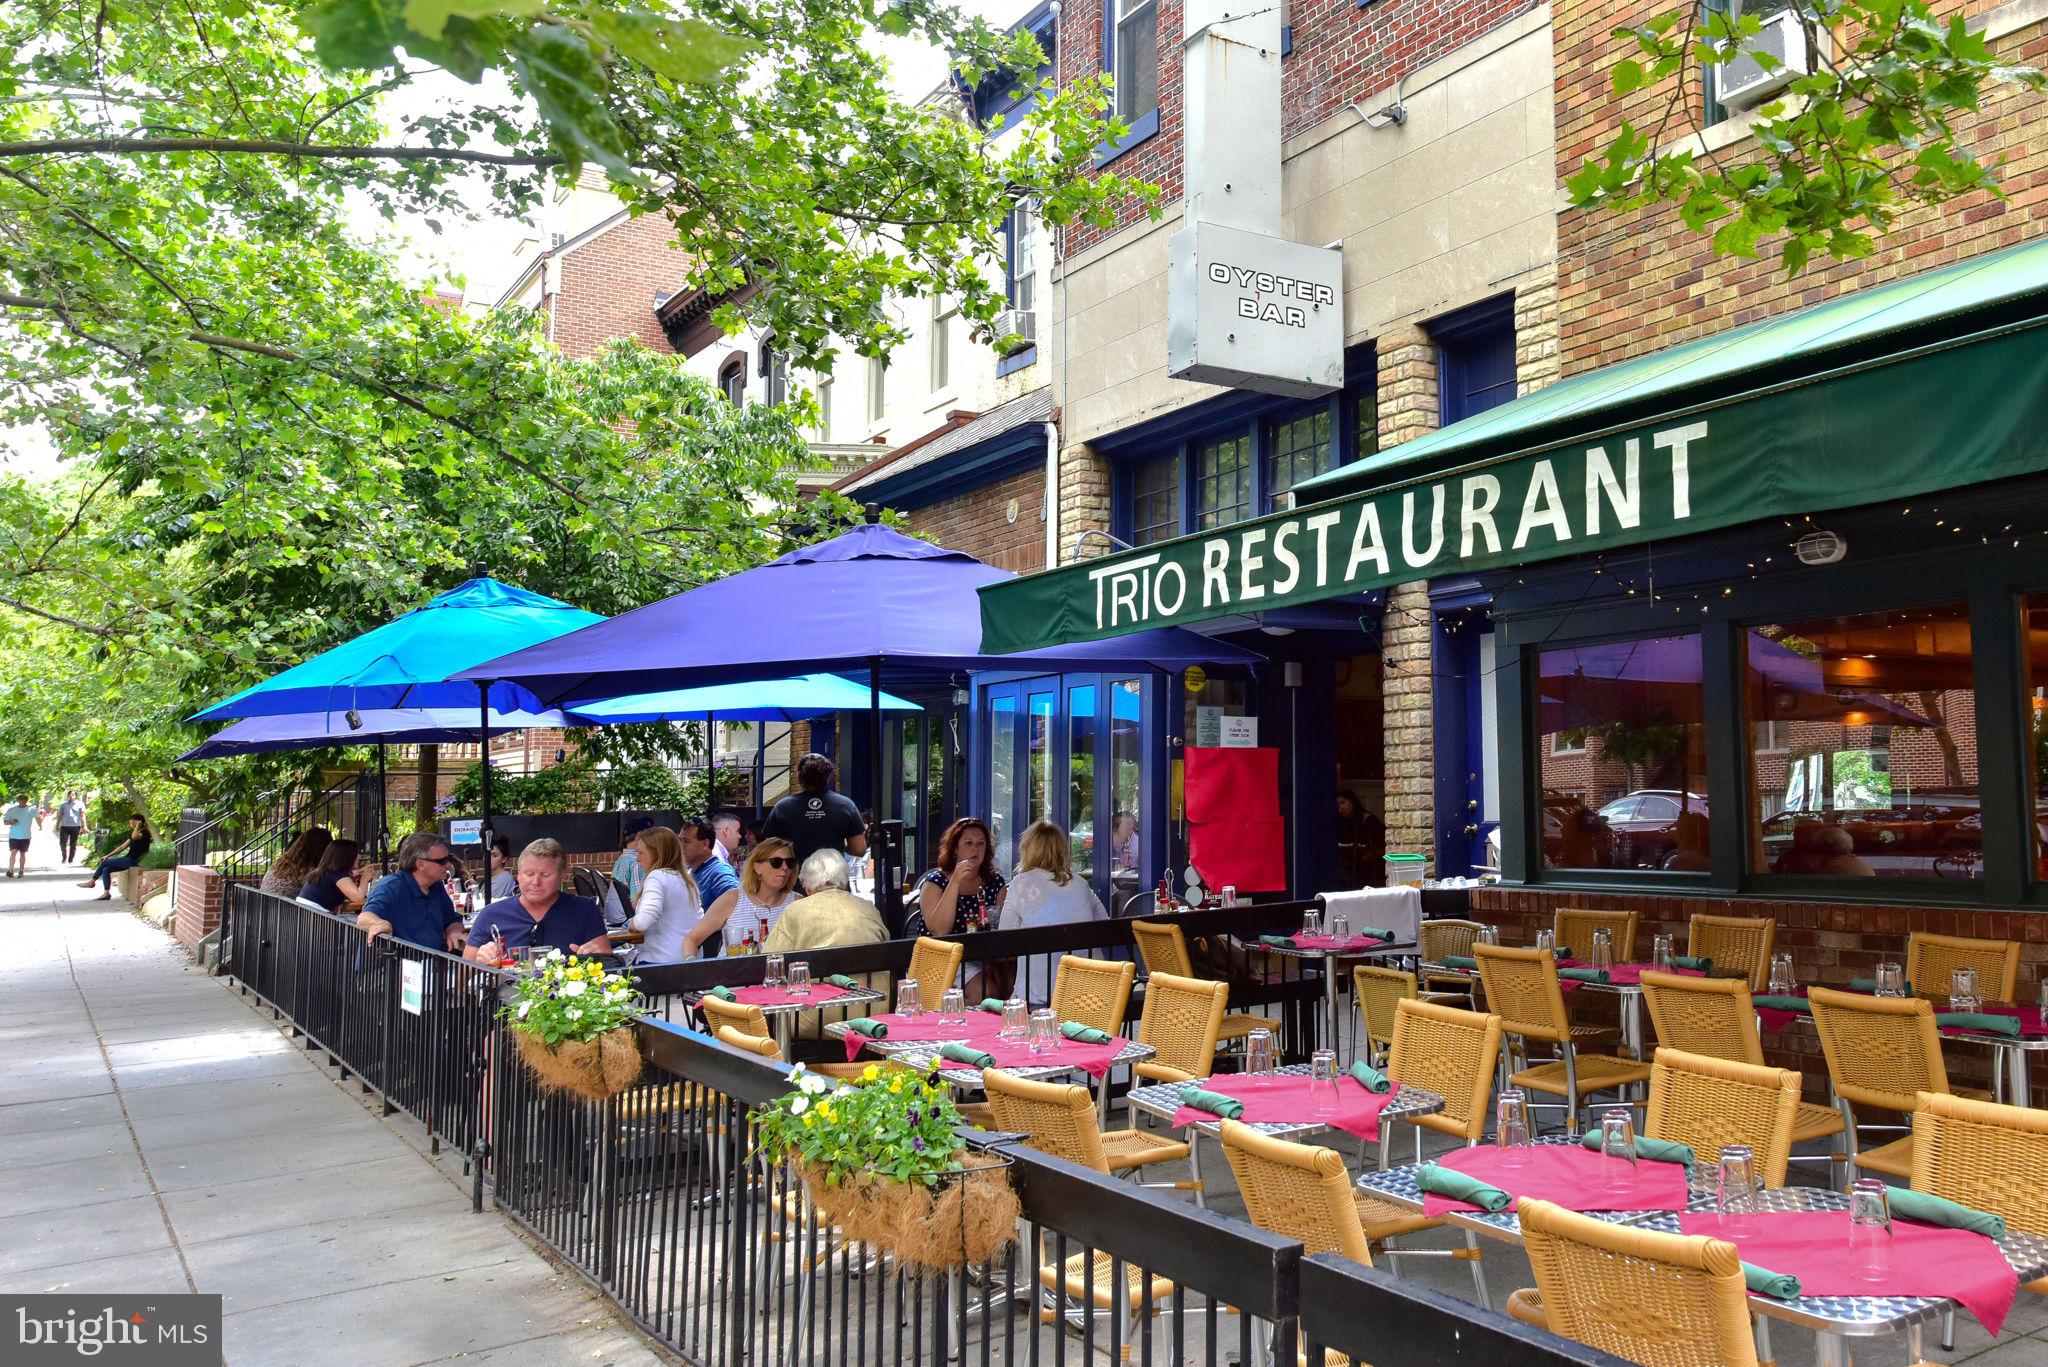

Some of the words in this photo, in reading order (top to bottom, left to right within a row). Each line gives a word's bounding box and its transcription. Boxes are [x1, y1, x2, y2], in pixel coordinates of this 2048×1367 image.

[1209, 263, 1333, 305] OYSTER
[1239, 298, 1305, 328] BAR
[1089, 553, 1187, 629] TRIO
[1203, 422, 1708, 607] RESTAURANT
